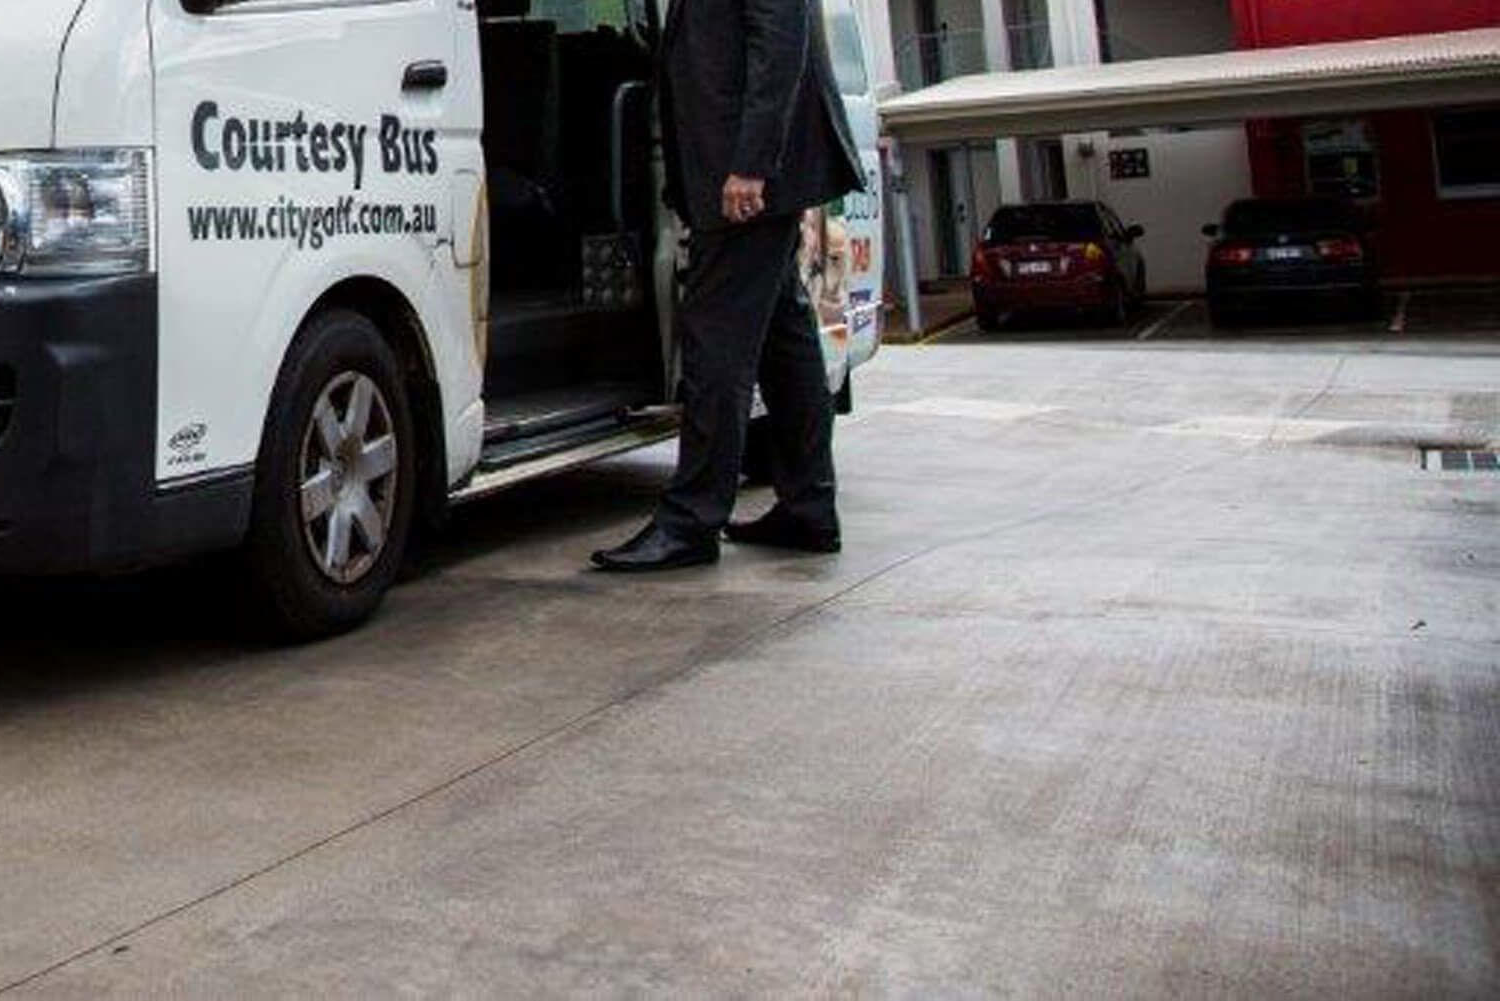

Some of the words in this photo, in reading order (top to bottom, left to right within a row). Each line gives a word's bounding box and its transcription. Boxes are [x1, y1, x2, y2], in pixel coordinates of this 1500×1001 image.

[192, 101, 367, 190] Courtesy
[379, 114, 439, 175] Bus
[188, 196, 436, 250] www.citygolf.com.au
